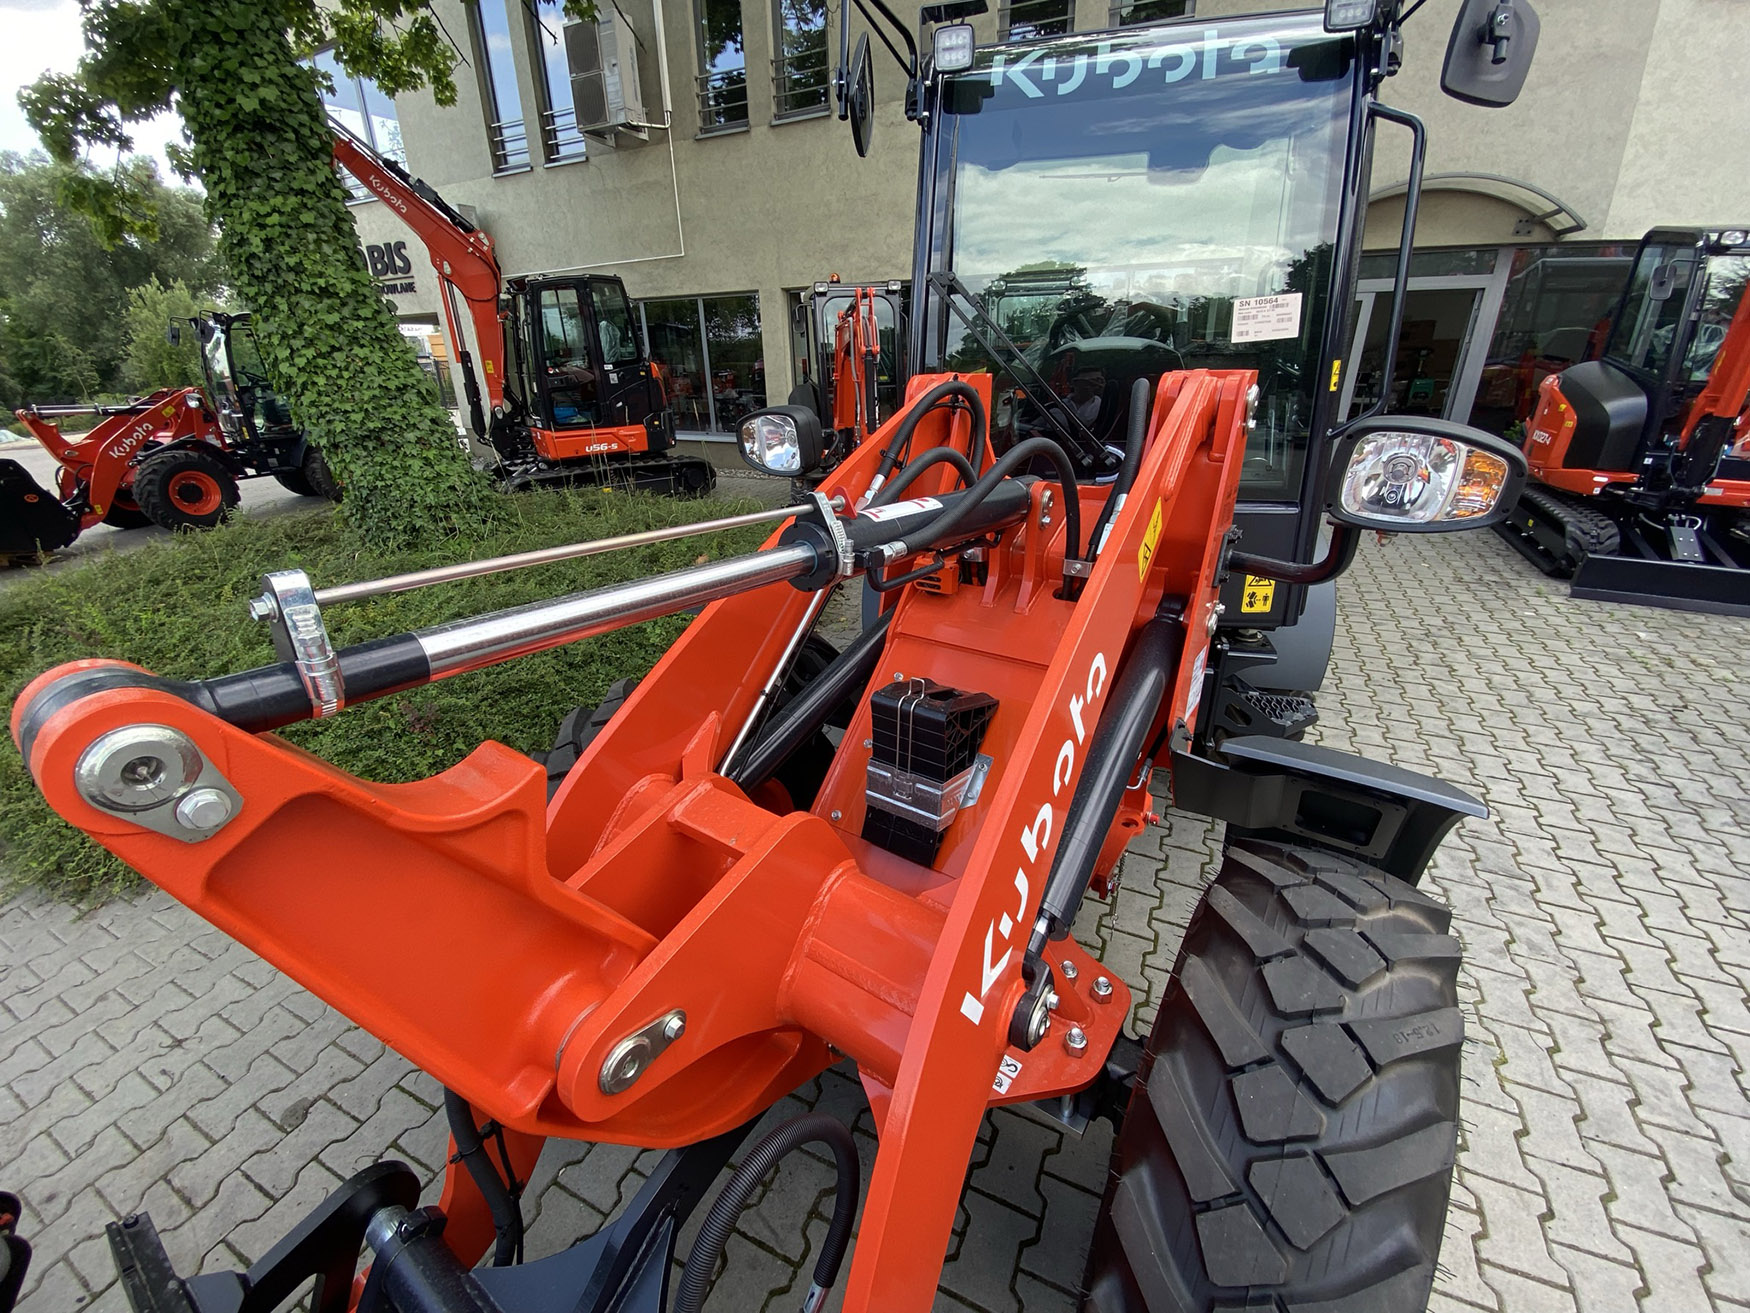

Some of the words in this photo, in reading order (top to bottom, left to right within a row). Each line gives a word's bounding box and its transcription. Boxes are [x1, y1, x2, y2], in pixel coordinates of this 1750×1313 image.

[990, 29, 1281, 98] Kubota
[369, 174, 407, 213] Kubota
[381, 282, 416, 295] OWLANE
[1254, 297, 1278, 305] 10564
[109, 422, 154, 459] Kubota
[960, 652, 1106, 1026] Kubota
